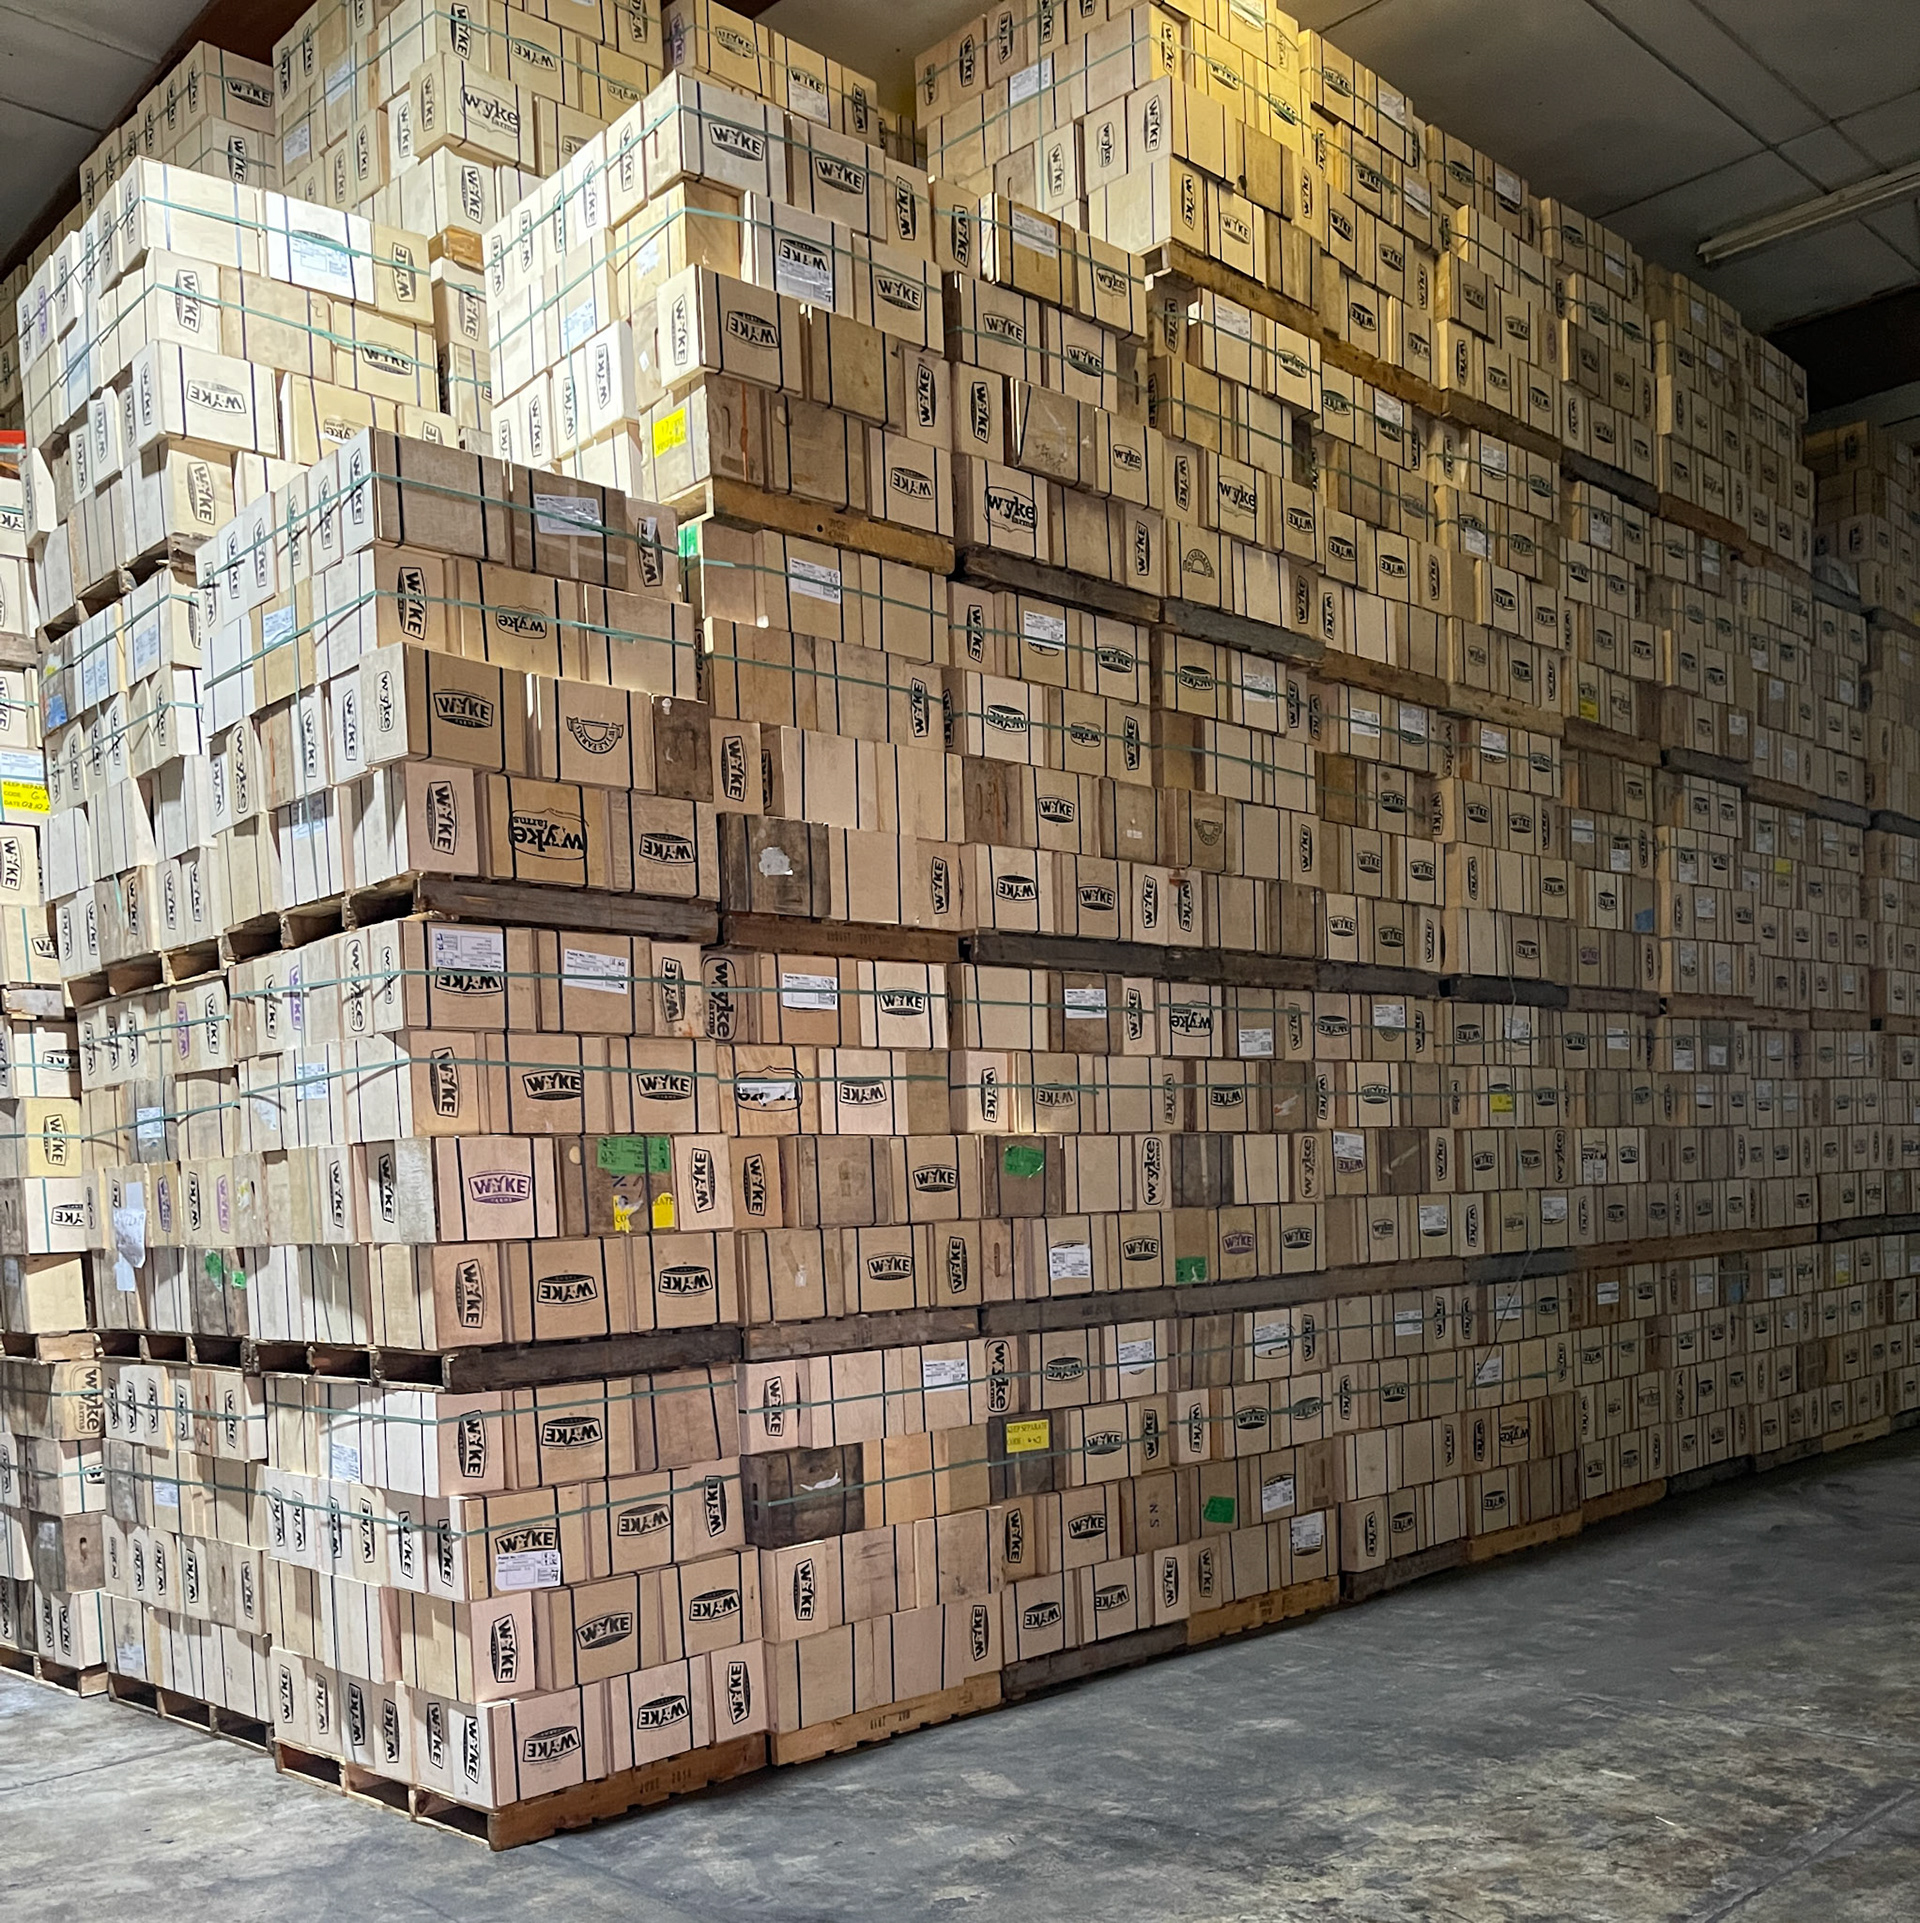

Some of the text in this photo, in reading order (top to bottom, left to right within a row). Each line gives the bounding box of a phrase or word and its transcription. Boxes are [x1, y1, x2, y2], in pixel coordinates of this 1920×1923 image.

[456, 5, 469, 57] WYKE
[1163, 26, 1175, 71] WYKE
[514, 43, 554, 68] WYKE
[963, 40, 973, 85] WYKE
[422, 78, 434, 128] WYKE
[791, 69, 823, 92] WYKE
[464, 91, 518, 125] wyke
[1146, 99, 1159, 149] WYKE
[399, 108, 410, 157] WYKE
[712, 127, 762, 156] WYKE
[233, 139, 246, 182] WYKE
[819, 161, 863, 192] WYKE
[1051, 147, 1063, 195] WYKE
[467, 167, 480, 222] WYKE
[1184, 177, 1194, 225] WYKE
[954, 210, 967, 262] WYKE
[1223, 216, 1249, 240] WYKE
[395, 246, 411, 300] WYKE
[879, 278, 920, 304] WYKE
[1098, 273, 1125, 291] wyke
[183, 274, 196, 328] WYKE
[675, 302, 687, 361] WYKE
[730, 316, 777, 345] WYKE
[986, 316, 1023, 340] WYKE
[366, 346, 410, 371] WYKE
[1068, 346, 1101, 368] WYKE
[190, 388, 242, 410] WYKE
[918, 369, 932, 422] WYKE
[976, 386, 988, 440] WYKE
[1114, 448, 1141, 465] wyke
[196, 466, 212, 519] WYKE
[893, 477, 932, 497] WYKE
[987, 493, 1035, 518] wyke
[1178, 461, 1189, 507] WYKE
[1219, 482, 1257, 507] wyke
[1137, 526, 1148, 572] WYKE
[405, 571, 421, 636] WYKE
[498, 614, 545, 633] wyke
[1325, 596, 1335, 638] WYKE
[968, 607, 981, 658] WYKE
[972, 609, 983, 660] WYKE
[345, 695, 357, 757] WYKE
[437, 697, 491, 722] WYKE
[912, 683, 925, 733] WYKE
[304, 715, 316, 775] WYKE
[1126, 720, 1136, 767] WYKE
[729, 740, 744, 797] WYKE
[434, 785, 451, 850] WYKE
[513, 815, 550, 828] farms
[1039, 801, 1073, 816] WYKE
[513, 825, 585, 852] wyke
[641, 839, 692, 861] WYKE
[4, 841, 18, 887] WYKE
[1358, 855, 1380, 868] WYKE
[166, 875, 175, 929] WYKE
[934, 860, 945, 910] WYKE
[999, 884, 1035, 899] WYKE
[1081, 891, 1113, 905] WYKE
[1143, 880, 1154, 925] WYKE
[1181, 884, 1192, 930] WYKE
[128, 883, 137, 933] WYKE
[1331, 918, 1355, 932] WYKE
[440, 973, 499, 991] WYKE
[711, 962, 734, 1037] wyke
[882, 995, 922, 1009] WYKE
[1129, 991, 1140, 1037] WYKE
[1171, 1013, 1212, 1032] wyke
[439, 1052, 456, 1113] WYKE
[527, 1074, 581, 1092] WYKE
[642, 1077, 691, 1092] WYKE
[843, 1087, 883, 1103] WYKE
[985, 1072, 997, 1118] WYKE
[1039, 1089, 1073, 1105] WYKE
[1213, 1091, 1241, 1105] WYKE
[49, 1118, 64, 1164] WYKE
[473, 1176, 527, 1195] WYKE
[696, 1152, 709, 1209] WYKE
[748, 1159, 763, 1213] WYKE
[916, 1171, 955, 1186] WYKE
[1145, 1141, 1158, 1202] wyke
[1302, 1138, 1316, 1195] wyke
[331, 1167, 344, 1226] WYKE
[380, 1160, 393, 1220] WYKE
[381, 1159, 395, 1221] WYKE
[54, 1210, 84, 1224] YKE
[1284, 1230, 1311, 1243] WYKE
[1125, 1241, 1157, 1255] WYKE
[1225, 1235, 1253, 1248] WYKE
[663, 1275, 709, 1290] WYKE
[871, 1259, 910, 1273] WYKE
[950, 1239, 963, 1290] WYKE
[462, 1265, 480, 1323] WYKE
[542, 1281, 594, 1299] WYKE
[991, 1344, 1005, 1410] wyke
[466, 1418, 482, 1475] WYKE
[545, 1425, 598, 1443] WYKE
[1088, 1433, 1121, 1446] WYKE
[1191, 1407, 1202, 1450] WYKE
[500, 1531, 553, 1552] WYKE
[620, 1511, 668, 1532] WYKE
[1009, 1513, 1021, 1560] WYKE
[1071, 1515, 1105, 1532] WYKE
[1367, 1515, 1376, 1555] WYKE
[440, 1522, 453, 1583] WYKE
[1202, 1551, 1212, 1596] WYKE
[800, 1563, 813, 1618] WYKE
[1096, 1587, 1127, 1607] WYKE
[1165, 1560, 1177, 1604] WYKE
[580, 1616, 629, 1641] WYKE
[693, 1600, 738, 1617] WYKE
[1025, 1608, 1059, 1625] WYKE
[500, 1618, 515, 1680] WYKE
[972, 1608, 986, 1657] WYKE
[281, 1669, 293, 1720] WYKE
[641, 1701, 687, 1725] WYKE
[730, 1664, 744, 1721] WYKE
[350, 1688, 363, 1743] WYKE
[385, 1702, 398, 1760] WYKE
[429, 1705, 443, 1765] WYKE
[466, 1719, 480, 1781] WYKE
[527, 1733, 578, 1752] WYKE
